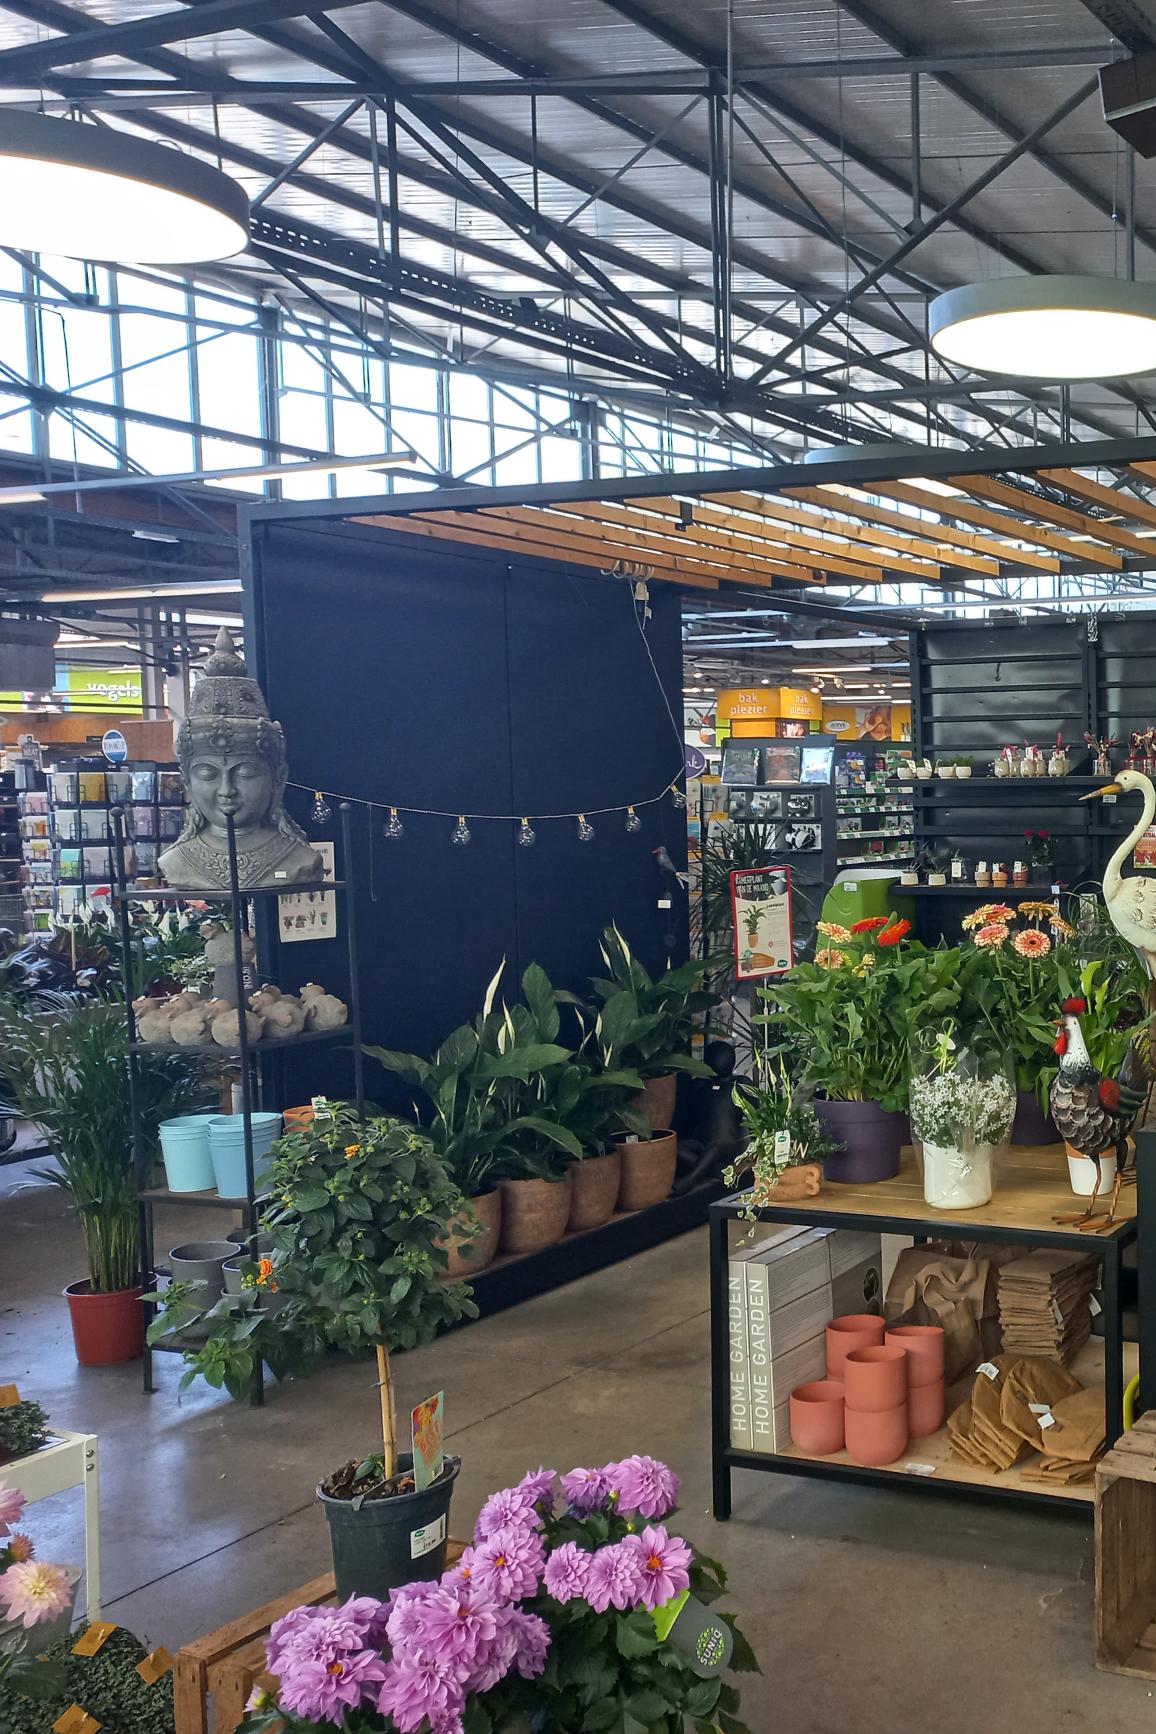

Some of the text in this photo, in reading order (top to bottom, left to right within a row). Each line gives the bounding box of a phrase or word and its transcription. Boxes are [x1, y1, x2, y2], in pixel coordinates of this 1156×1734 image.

[87, 681, 141, 702] vogels
[738, 692, 760, 703] bak
[795, 693, 809, 703] bak
[730, 704, 768, 716] plezier
[790, 706, 814, 716] plezier
[728, 1276, 747, 1432] HOME GARDEN
[749, 1279, 770, 1434] HOME GARDEN
[700, 1629, 723, 1666] SUNIQ
